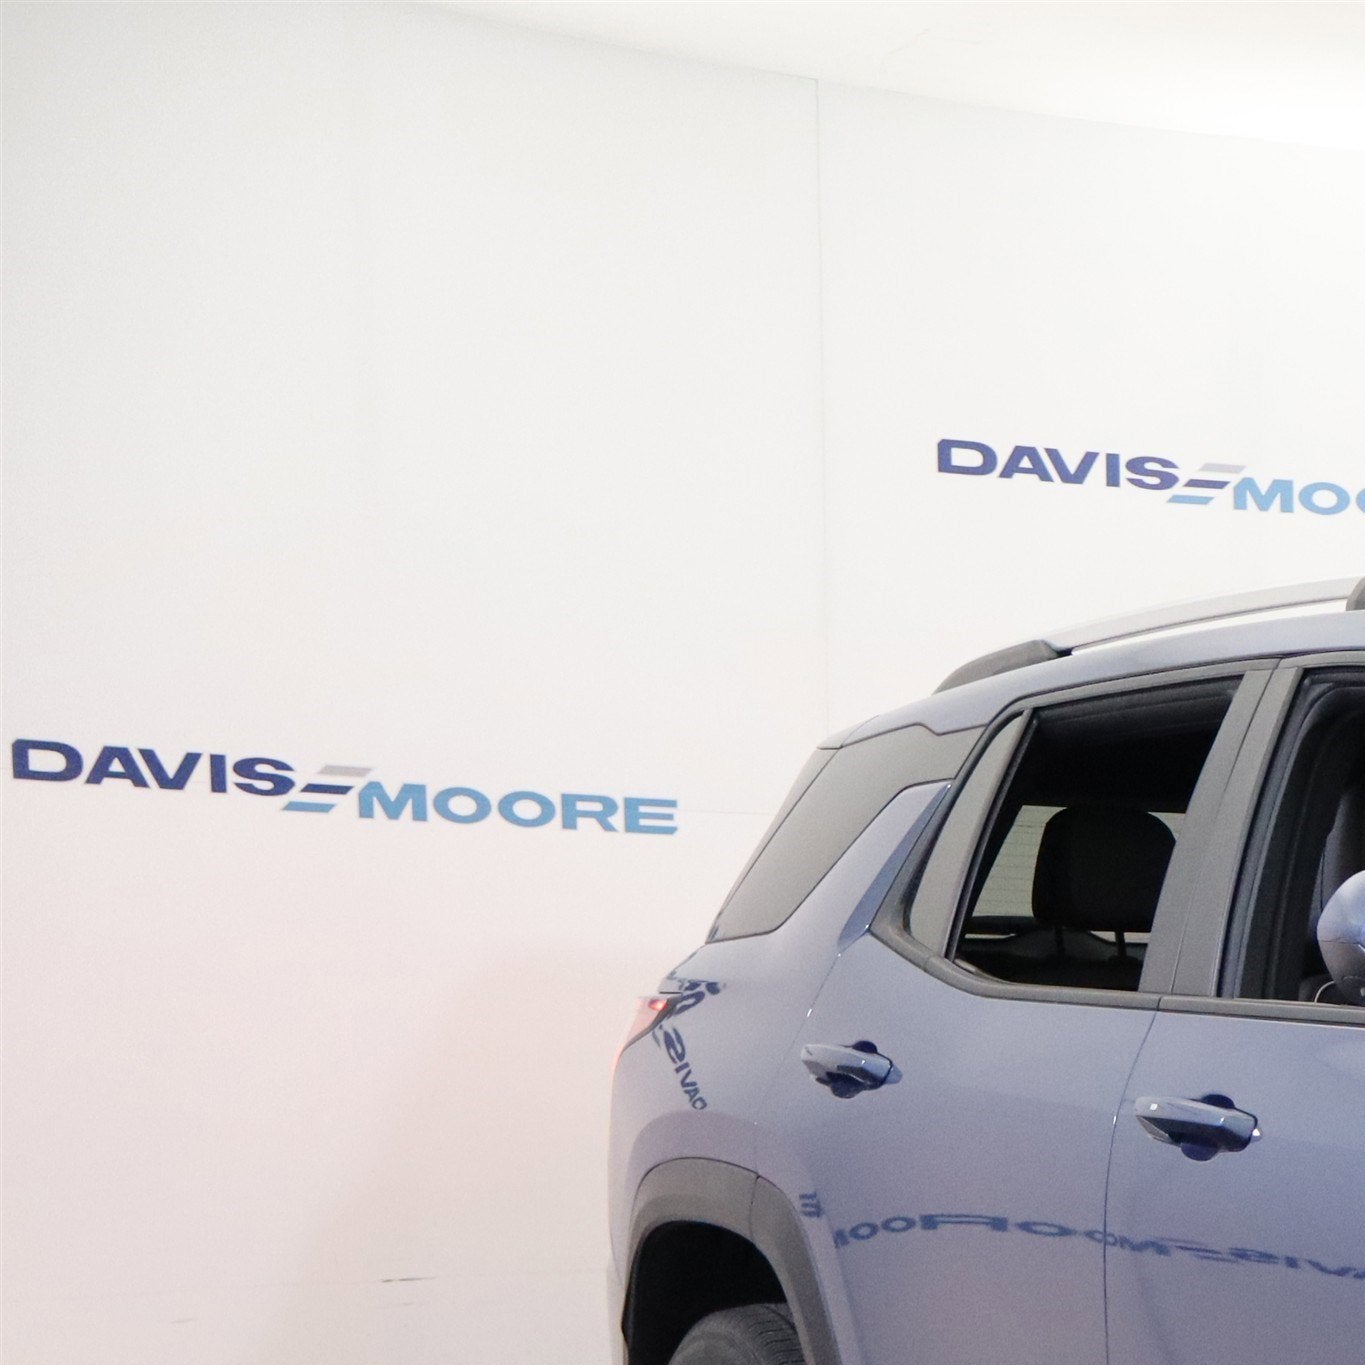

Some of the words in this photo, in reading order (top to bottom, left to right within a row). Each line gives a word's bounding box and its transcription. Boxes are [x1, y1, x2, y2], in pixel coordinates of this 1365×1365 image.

[936, 438, 1180, 491] DAVIS
[10, 737, 297, 798] DAVIS
[357, 780, 679, 836] MOORE
